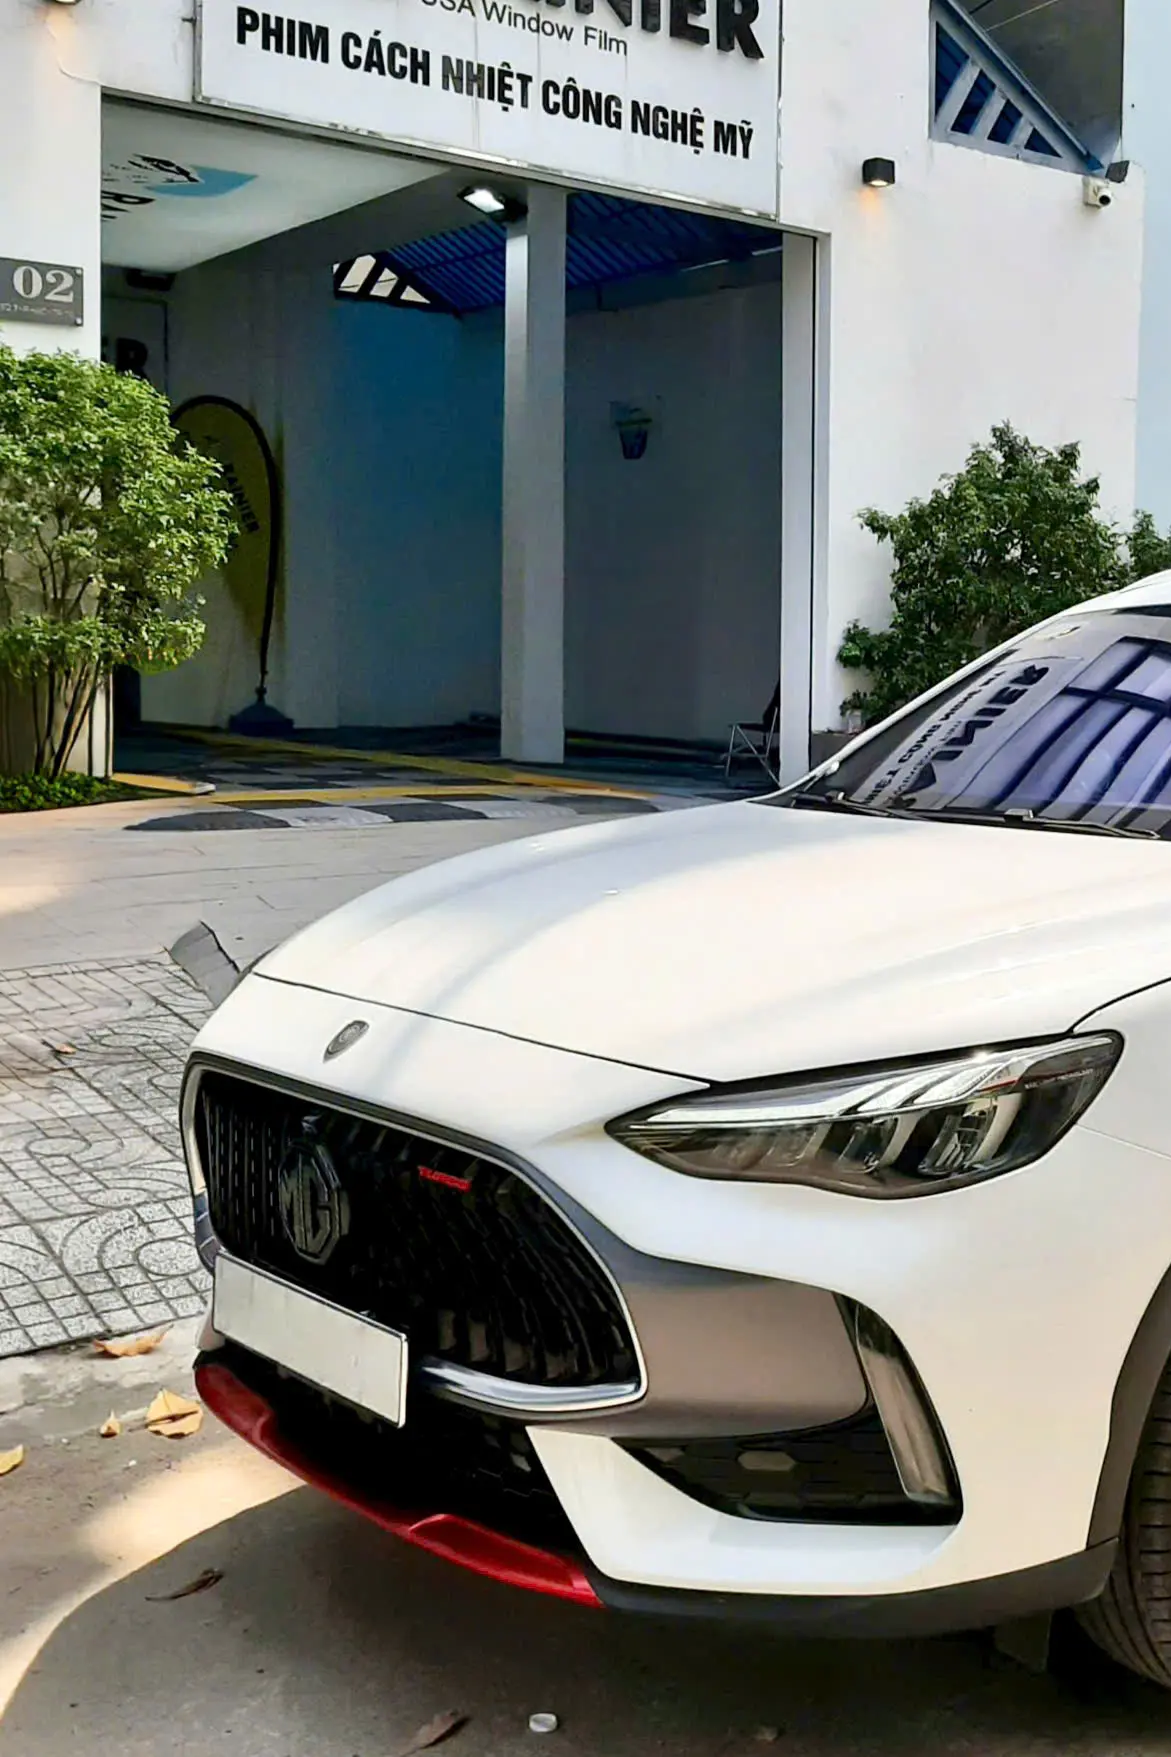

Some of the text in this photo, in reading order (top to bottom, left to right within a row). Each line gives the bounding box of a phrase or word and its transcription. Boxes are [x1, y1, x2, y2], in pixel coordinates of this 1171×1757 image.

[421, 0, 628, 56] SA Window Film
[237, 6, 754, 159] PHIM CÁCH NHIỆT CÔNG NGHỆ MỸ
[13, 265, 75, 303] 02
